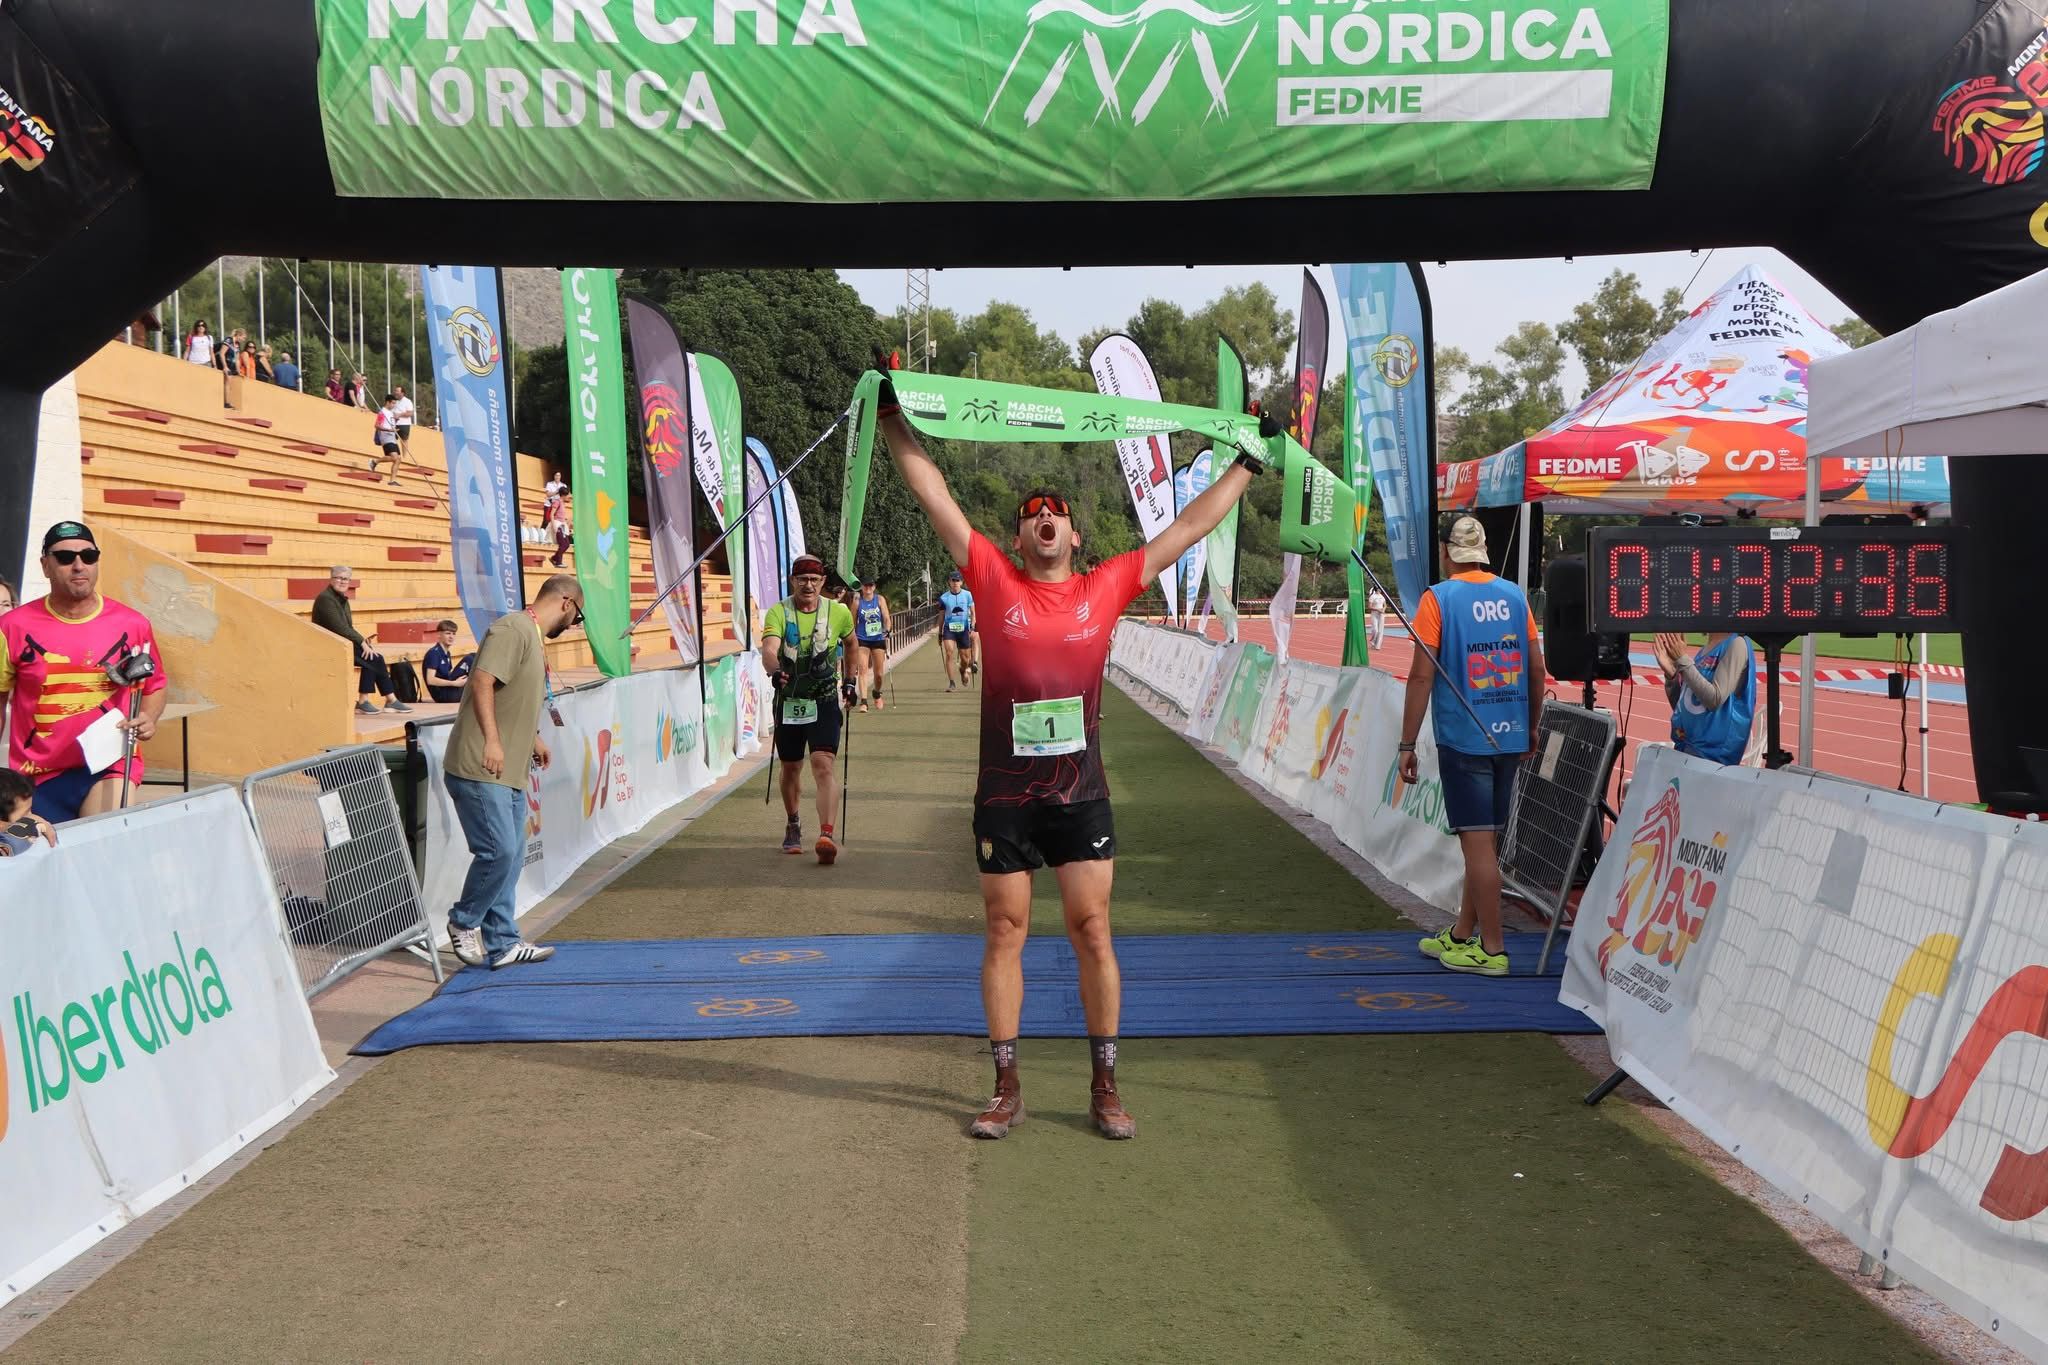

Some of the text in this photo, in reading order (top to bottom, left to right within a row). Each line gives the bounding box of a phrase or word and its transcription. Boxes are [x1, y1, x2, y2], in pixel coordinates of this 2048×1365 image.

[367, 0, 868, 46] MARCHA
[1276, 2, 1614, 66] NÓRDICA
[369, 45, 727, 131] NÓRDICA
[1289, 86, 1423, 116] FEDME
[1738, 280, 1785, 297] TIEMPO
[1744, 288, 1779, 301] PARA
[1750, 296, 1777, 307] LOS
[1733, 303, 1800, 324] DEPORTES
[1753, 311, 1769, 319] DE
[1709, 328, 1785, 341] FEDME
[1007, 401, 1063, 415] MARCHA
[1539, 457, 1621, 475] FEDME
[1842, 456, 1927, 472] FEDME
[1304, 468, 1312, 493] FEDME
[1610, 545, 1947, 618] 01:32:36
[1472, 599, 1511, 623] ORG
[793, 706, 807, 717] 59
[1044, 717, 1055, 738] 1
[13, 930, 233, 1114] Iberdrola
